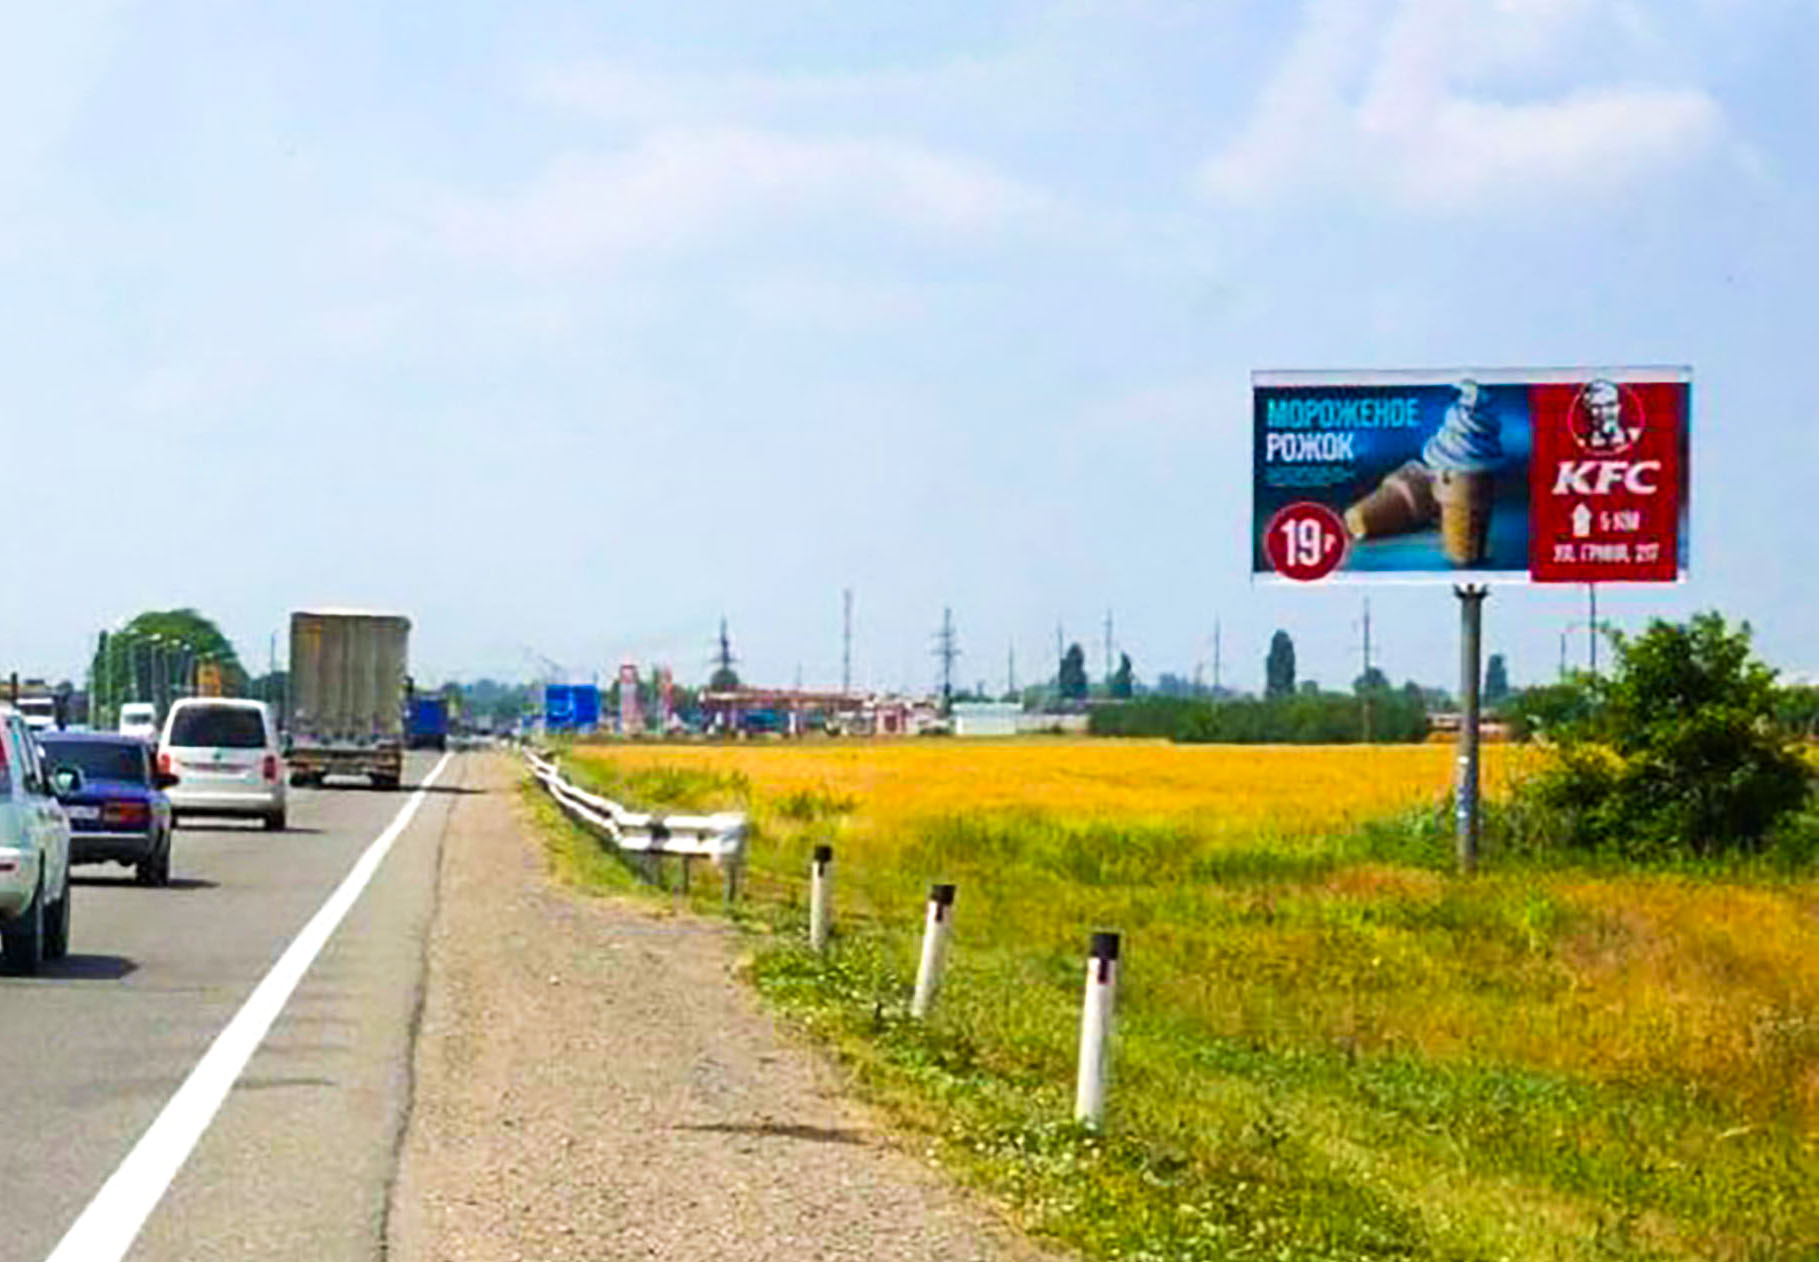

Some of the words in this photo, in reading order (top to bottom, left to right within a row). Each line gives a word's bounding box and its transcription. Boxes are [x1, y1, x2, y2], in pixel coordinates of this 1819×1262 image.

[1267, 398, 1420, 428] МОРОЖЕНОЕ
[1266, 432, 1354, 462] РОЖОК
[1551, 460, 1662, 495] KFC
